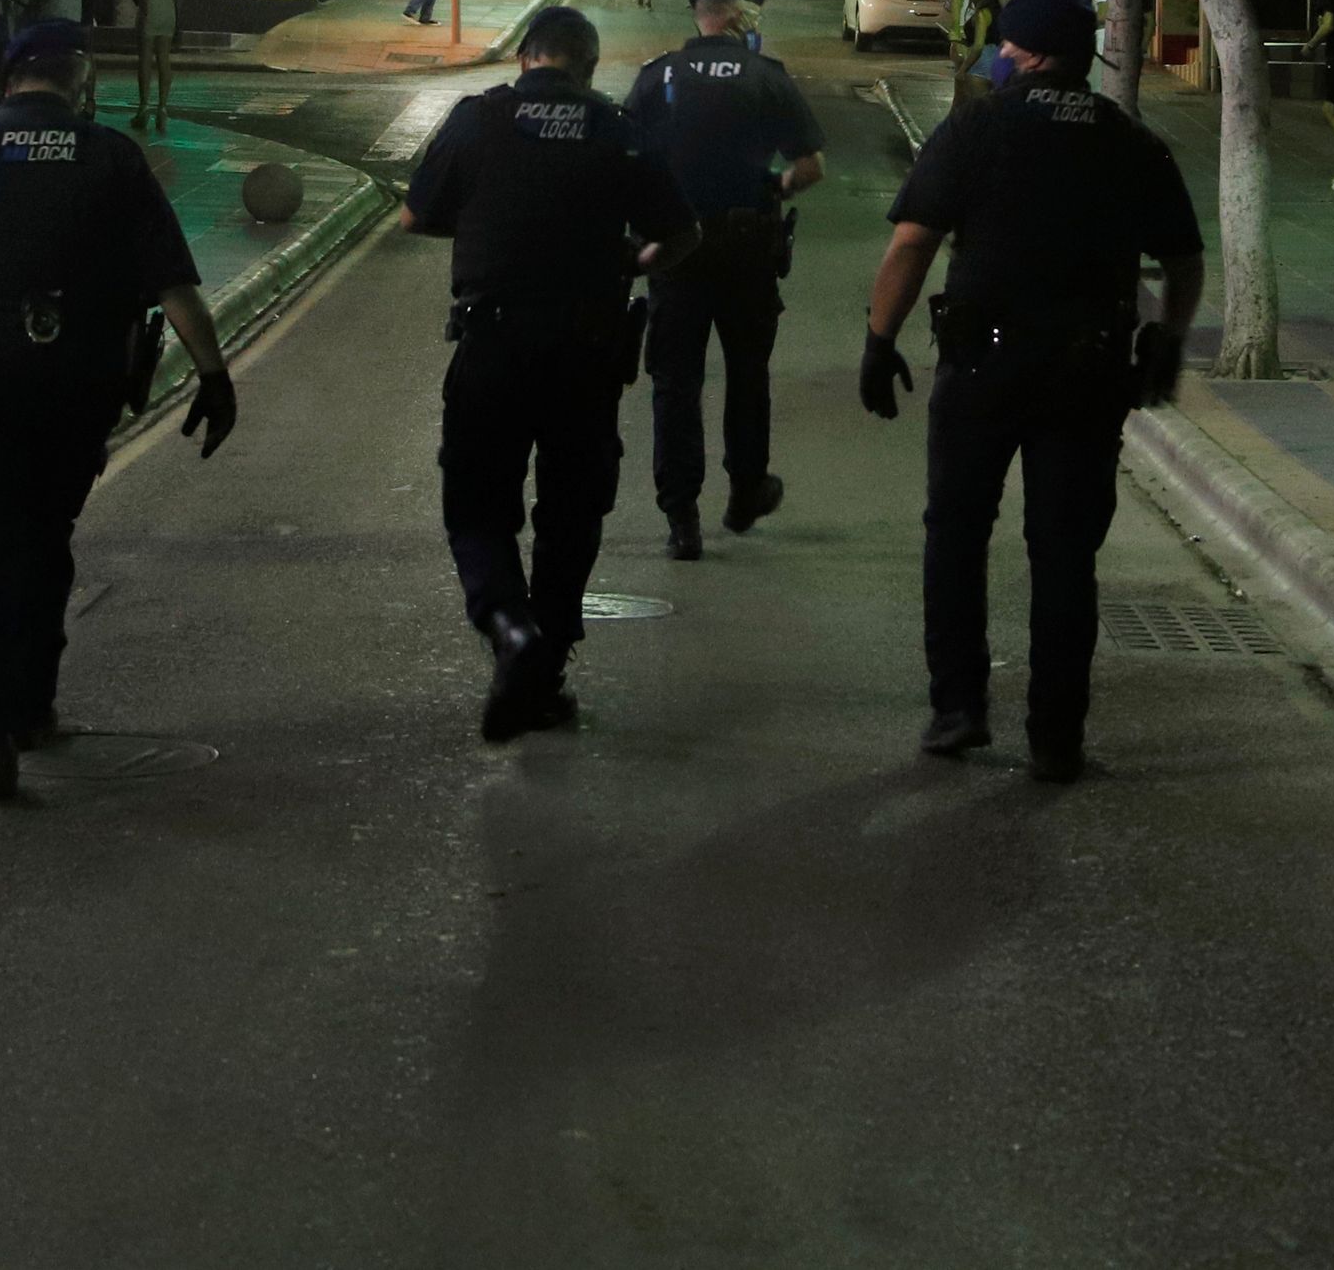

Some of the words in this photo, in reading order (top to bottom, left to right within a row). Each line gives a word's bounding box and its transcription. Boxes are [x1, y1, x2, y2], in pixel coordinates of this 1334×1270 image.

[1025, 88, 1095, 108] POLICIA
[514, 102, 587, 120] POLICIA
[1051, 105, 1097, 123] LOCAL
[1, 130, 76, 146] POLICIA
[539, 121, 586, 140] LOCAL
[27, 145, 76, 162] LOCAL
